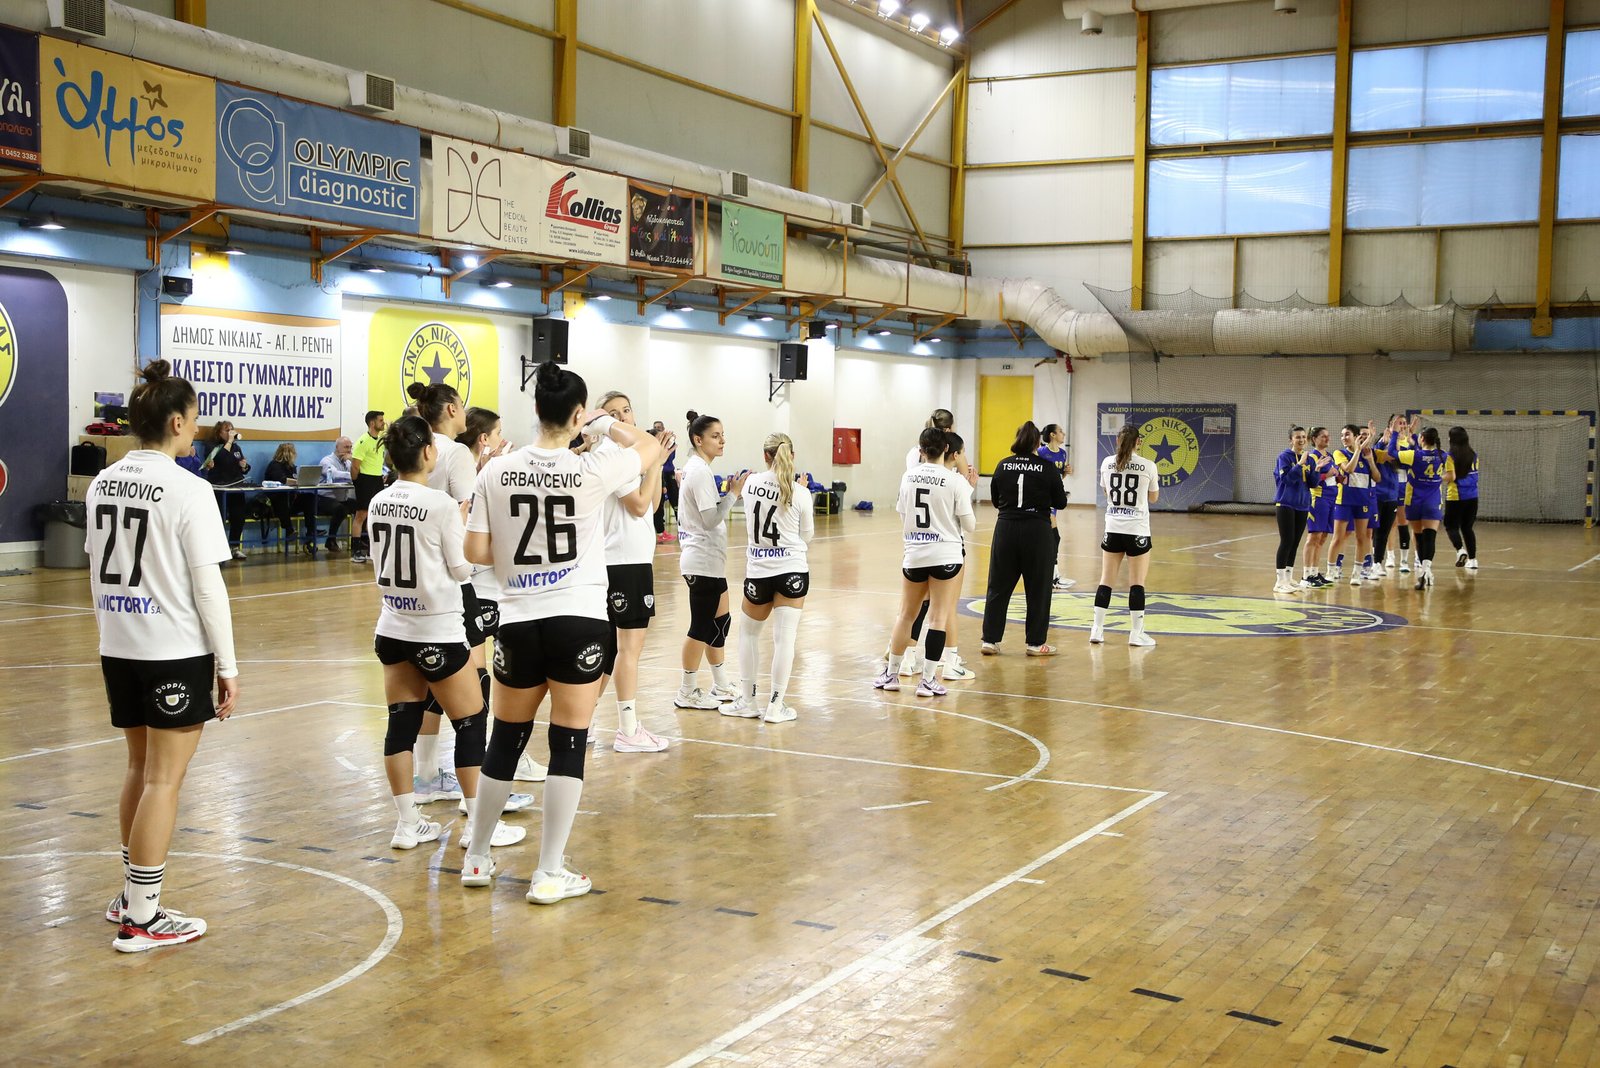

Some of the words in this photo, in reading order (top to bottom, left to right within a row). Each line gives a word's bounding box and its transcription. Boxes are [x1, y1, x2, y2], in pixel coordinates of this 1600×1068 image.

[22, 152, 37, 161] 3382
[137, 144, 203, 164] μεζεδοπωλείο
[141, 156, 198, 175] μικρολίμανο
[293, 137, 411, 184] OLYMPIC
[299, 169, 407, 210] diagnostic
[545, 171, 622, 224] Kollias
[504, 223, 528, 233] BEAUTY
[504, 234, 528, 244] CENTER
[603, 223, 618, 233] Group
[732, 232, 780, 262] Κουνούπι
[173, 325, 215, 346] ΔΗΜΟΣ
[219, 329, 262, 349] ΝΙΚΑΙΑΣ
[275, 334, 290, 351] ΑΓ.
[302, 336, 333, 354] ΡΕΝΤΗ
[431, 327, 468, 381] ΝΙΚΑΙΑΣ
[172, 359, 233, 384] ΚΛΕΙΣΤΟ
[239, 362, 332, 388] ΓΥΜΝΑΣΤΗΡΙΟ
[1161, 419, 1197, 452] ΝΙΚΑΙΑΣ
[501, 471, 582, 488] GRBAVCEVIC
[1003, 463, 1043, 472] TSIKNAKI
[94, 480, 164, 503] PREMOVIC
[1016, 473, 1024, 508] 1
[1109, 473, 1139, 506] 88
[371, 503, 428, 522] ANDRITSOU
[753, 500, 780, 546] 14
[915, 488, 931, 529] 5
[1109, 507, 1136, 516] VICTORY
[510, 494, 577, 565] 26
[909, 532, 940, 541] VICTORY
[95, 504, 149, 587] 27
[372, 522, 417, 589] 20
[750, 547, 786, 558] VICTORY
[101, 595, 152, 614] VICTORY
